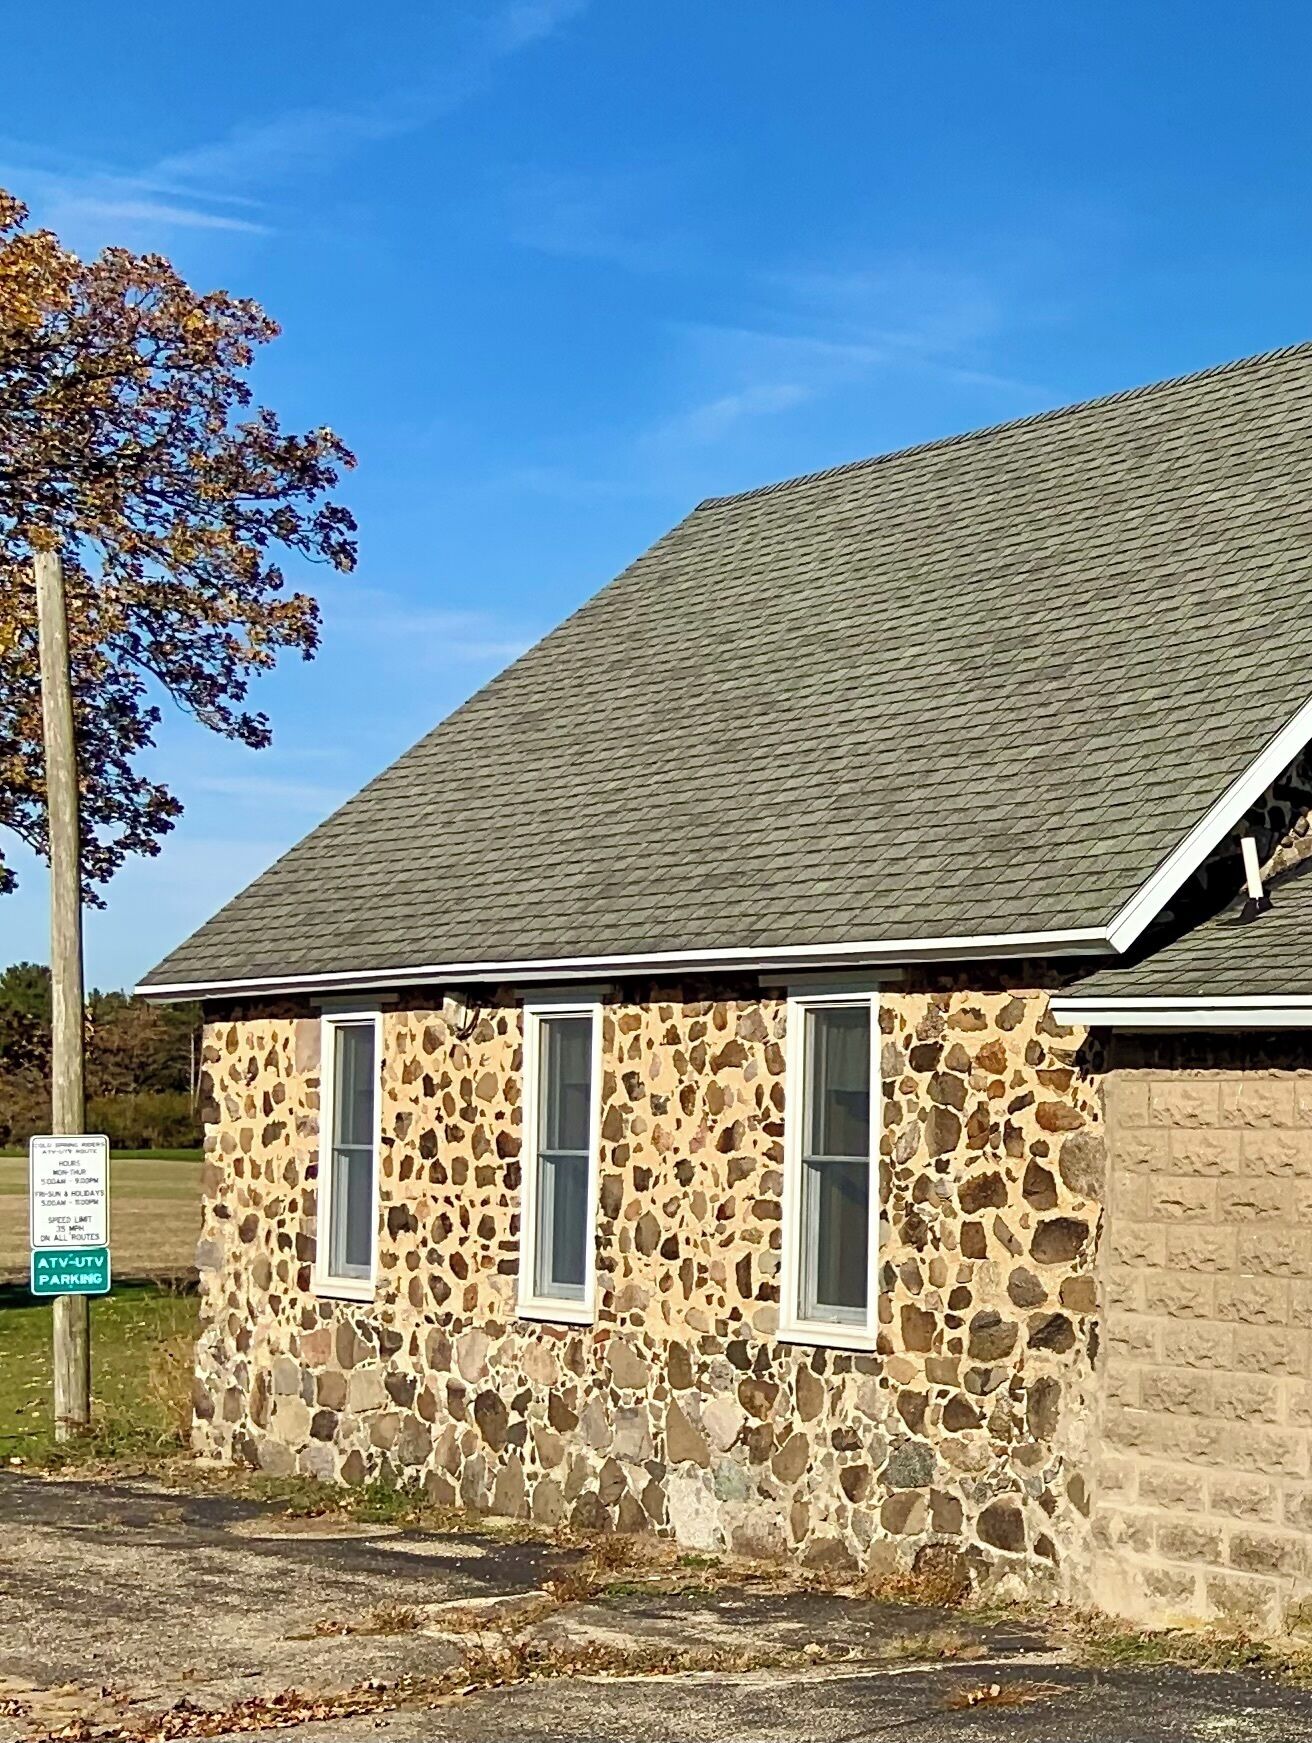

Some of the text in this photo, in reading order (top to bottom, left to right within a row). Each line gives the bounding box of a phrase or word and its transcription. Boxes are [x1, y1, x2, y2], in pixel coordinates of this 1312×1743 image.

[71, 1189, 104, 1197] HOLIDAYS
[48, 1215, 92, 1224] SPEED LIMIT
[40, 1234, 50, 1242] ON
[71, 1232, 100, 1240] ROUTES
[38, 1256, 104, 1269] ATV-UTV
[39, 1273, 103, 1286] PARKING
